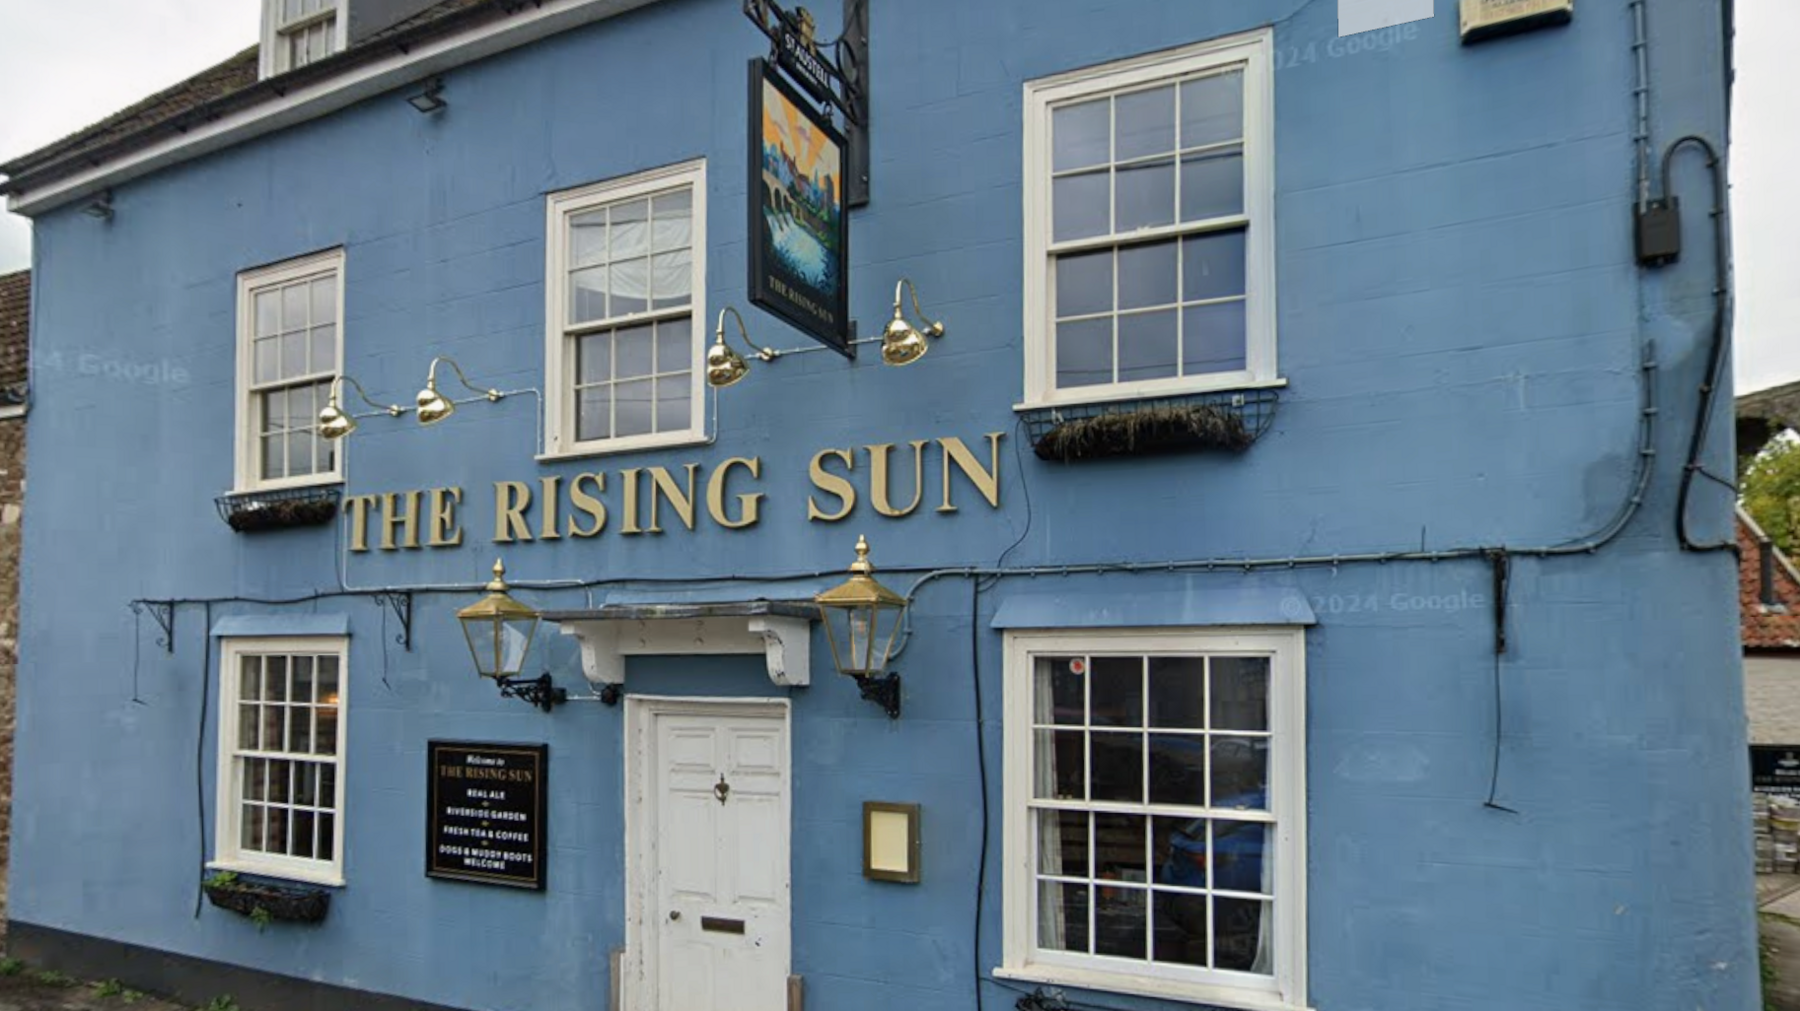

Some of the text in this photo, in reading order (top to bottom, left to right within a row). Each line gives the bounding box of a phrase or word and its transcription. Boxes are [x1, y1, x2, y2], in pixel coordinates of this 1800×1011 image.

[768, 274, 834, 324] THE RISING SUN
[342, 431, 1007, 551] THE RISING SUN
[465, 754, 496, 766] Welcome
[440, 765, 533, 783] THE RISING SUN
[466, 788, 506, 800] REAL ALE
[446, 805, 528, 822] RIVERSIDE GARDEN
[443, 825, 530, 842] FRESH TEA & COFFEE
[438, 843, 463, 855] DOGS
[471, 847, 502, 859] MUDDY
[503, 851, 533, 863] BOOTS
[463, 857, 506, 870] WELCOME
